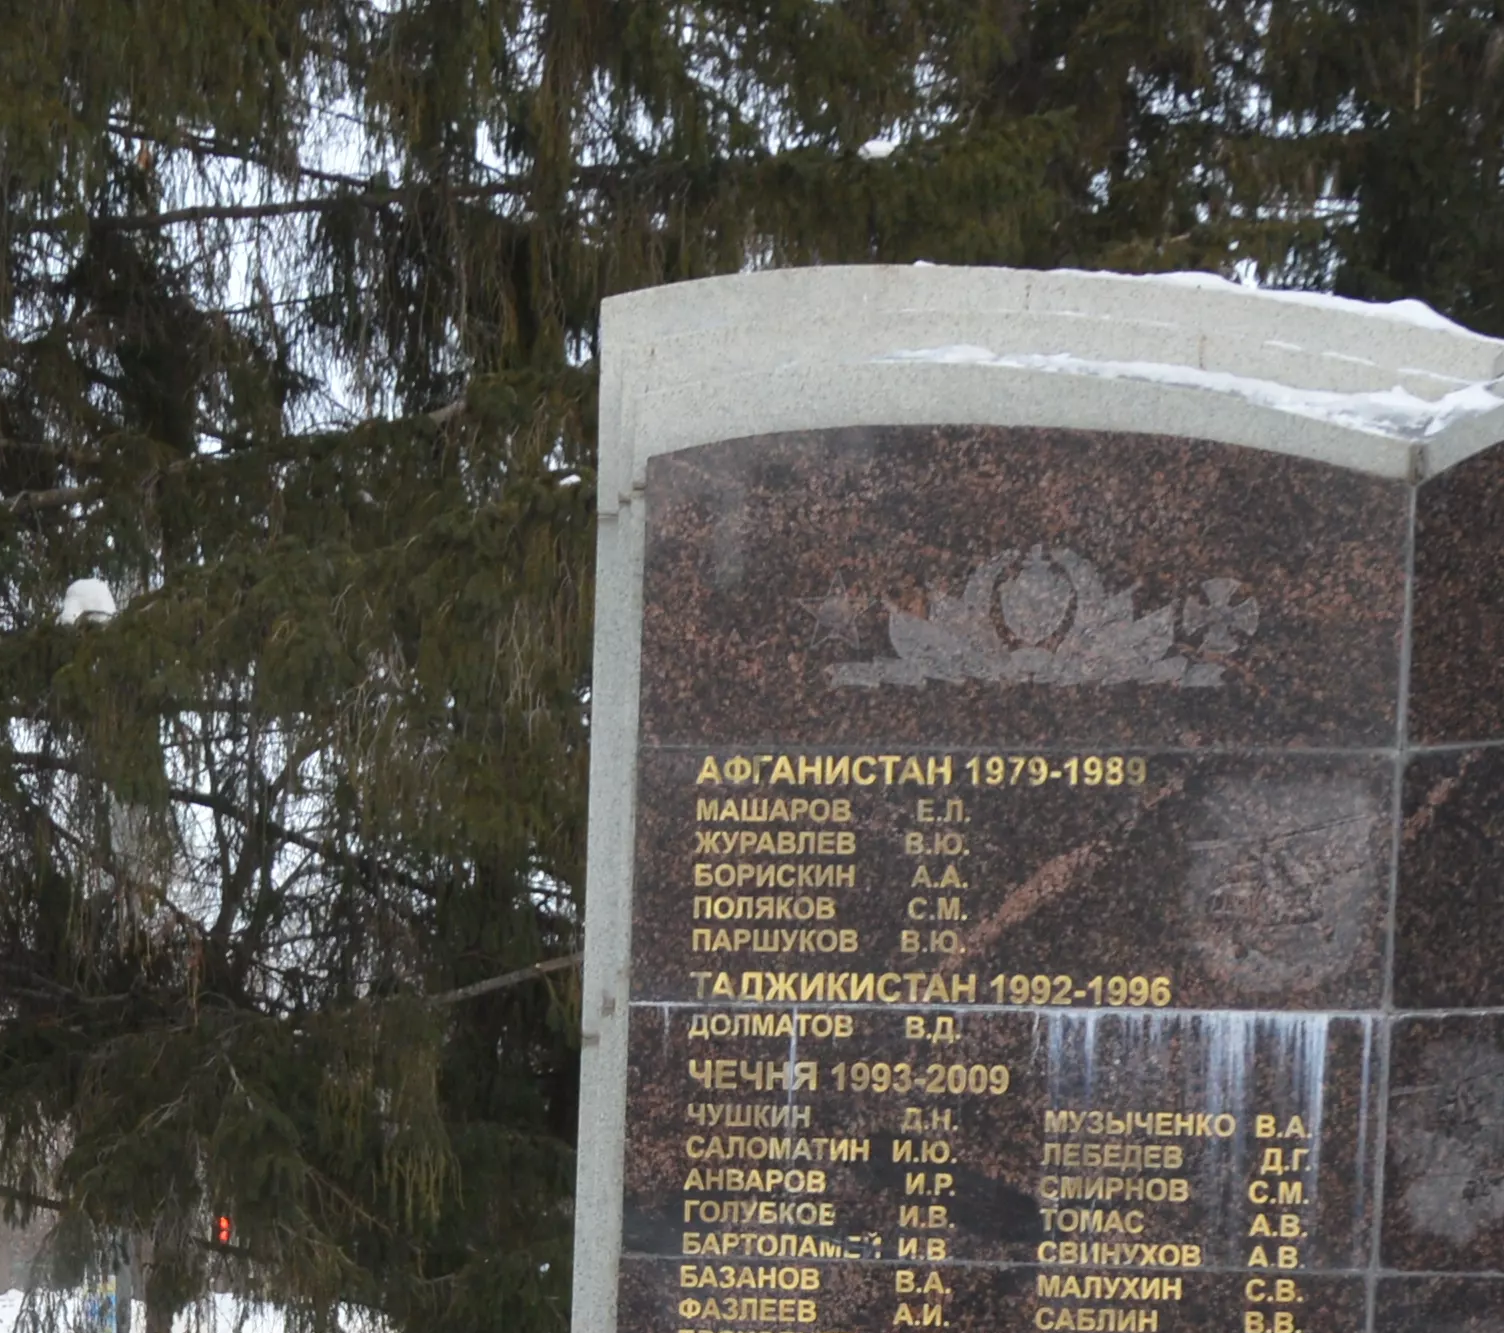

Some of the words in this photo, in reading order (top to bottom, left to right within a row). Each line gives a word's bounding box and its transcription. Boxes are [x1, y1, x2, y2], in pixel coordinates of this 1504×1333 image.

[696, 755, 952, 785] АФГАНИСТАН
[965, 756, 1147, 786] 1979-1989
[696, 798, 852, 823] МАШАРОВ
[916, 798, 972, 823] Е.Л.
[694, 831, 856, 856] ЖУРАВЛЕВ
[904, 831, 971, 856] В.Ю.
[694, 863, 856, 888] БОРИСКИН
[911, 864, 969, 889] А.А.
[692, 896, 836, 920] ПОЛЯКОВ
[907, 897, 969, 921] С.М.
[691, 928, 859, 953] ПАРШУКОВ
[900, 929, 967, 954] В.Ю.
[689, 971, 977, 1003] ТАДЖИКИСТАН
[988, 974, 1171, 1007] 1992-1996
[688, 1013, 854, 1040] ДОЛМАТОВ
[904, 1015, 962, 1044] В.Д.
[688, 1059, 819, 1091] ЧЕЧНЯ
[831, 1061, 1009, 1095] 1993-2009
[687, 1103, 812, 1129] ЧУШКИН
[900, 1106, 959, 1133] Д.Н.
[1043, 1110, 1236, 1138] МУЗЫЧЕНКО
[1254, 1114, 1313, 1139] В.А.
[685, 1135, 871, 1162] САЛОМАТИН
[891, 1139, 959, 1165] И.Ю.
[1040, 1143, 1184, 1172] ЛЕБЕДЕВ
[1259, 1147, 1312, 1176] Д.Г.
[683, 1168, 827, 1193] АНВАРОВ
[904, 1172, 957, 1197] И.Р.
[1039, 1175, 1190, 1203] СМИРНОВ
[1247, 1180, 1310, 1205] С.М.
[898, 1204, 957, 1230] И.В.
[1039, 1207, 1145, 1234] ТОМАС
[1248, 1212, 1309, 1238] А.В.
[1037, 1240, 1202, 1268] СВИНУХОВ
[679, 1264, 821, 1291] БАЗАНОВ
[894, 1269, 953, 1295] В.А.
[1036, 1273, 1183, 1301] МАЛУХИН
[1244, 1277, 1304, 1303] С.В.
[678, 1297, 817, 1323] ФАЗЛЕЕВ
[892, 1302, 951, 1328] А.И.
[1034, 1306, 1159, 1333] САБЛИН
